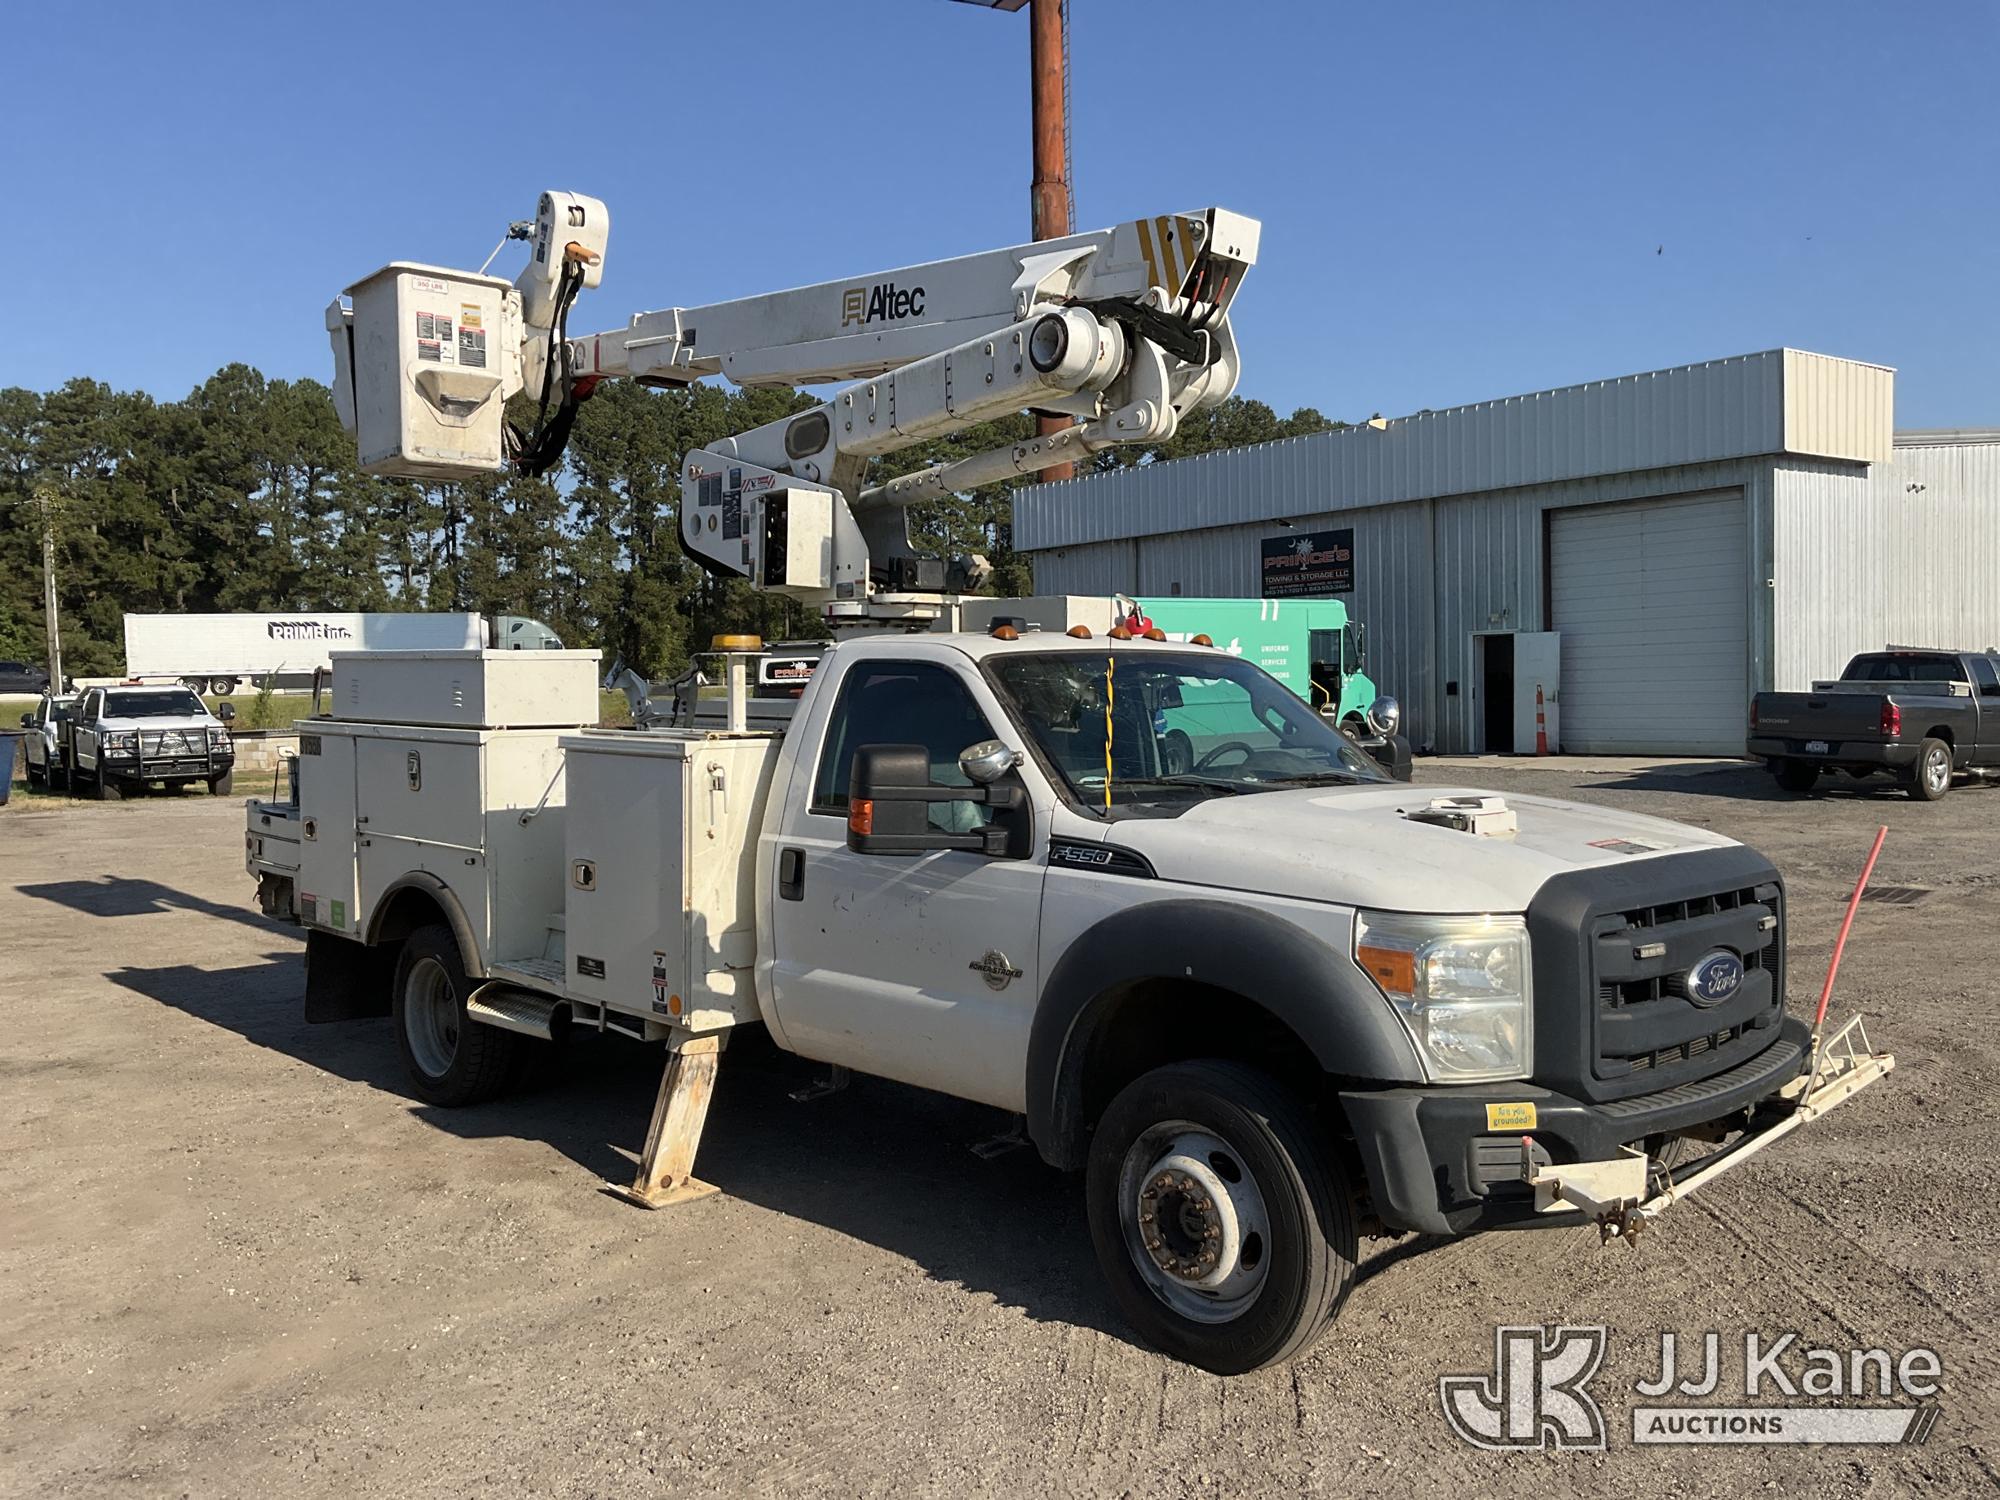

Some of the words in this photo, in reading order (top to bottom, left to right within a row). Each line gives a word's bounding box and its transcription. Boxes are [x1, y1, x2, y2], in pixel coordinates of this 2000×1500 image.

[865, 282, 926, 324] Altec
[1263, 544, 1350, 569] PRINCE'S
[1265, 576, 1293, 584] TOWING
[1301, 571, 1334, 581] STORAGE
[1335, 569, 1349, 577] LLC
[268, 621, 322, 640] PRIME
[1708, 963, 1738, 994] Ford
[1493, 1115, 1532, 1127] grounded?
